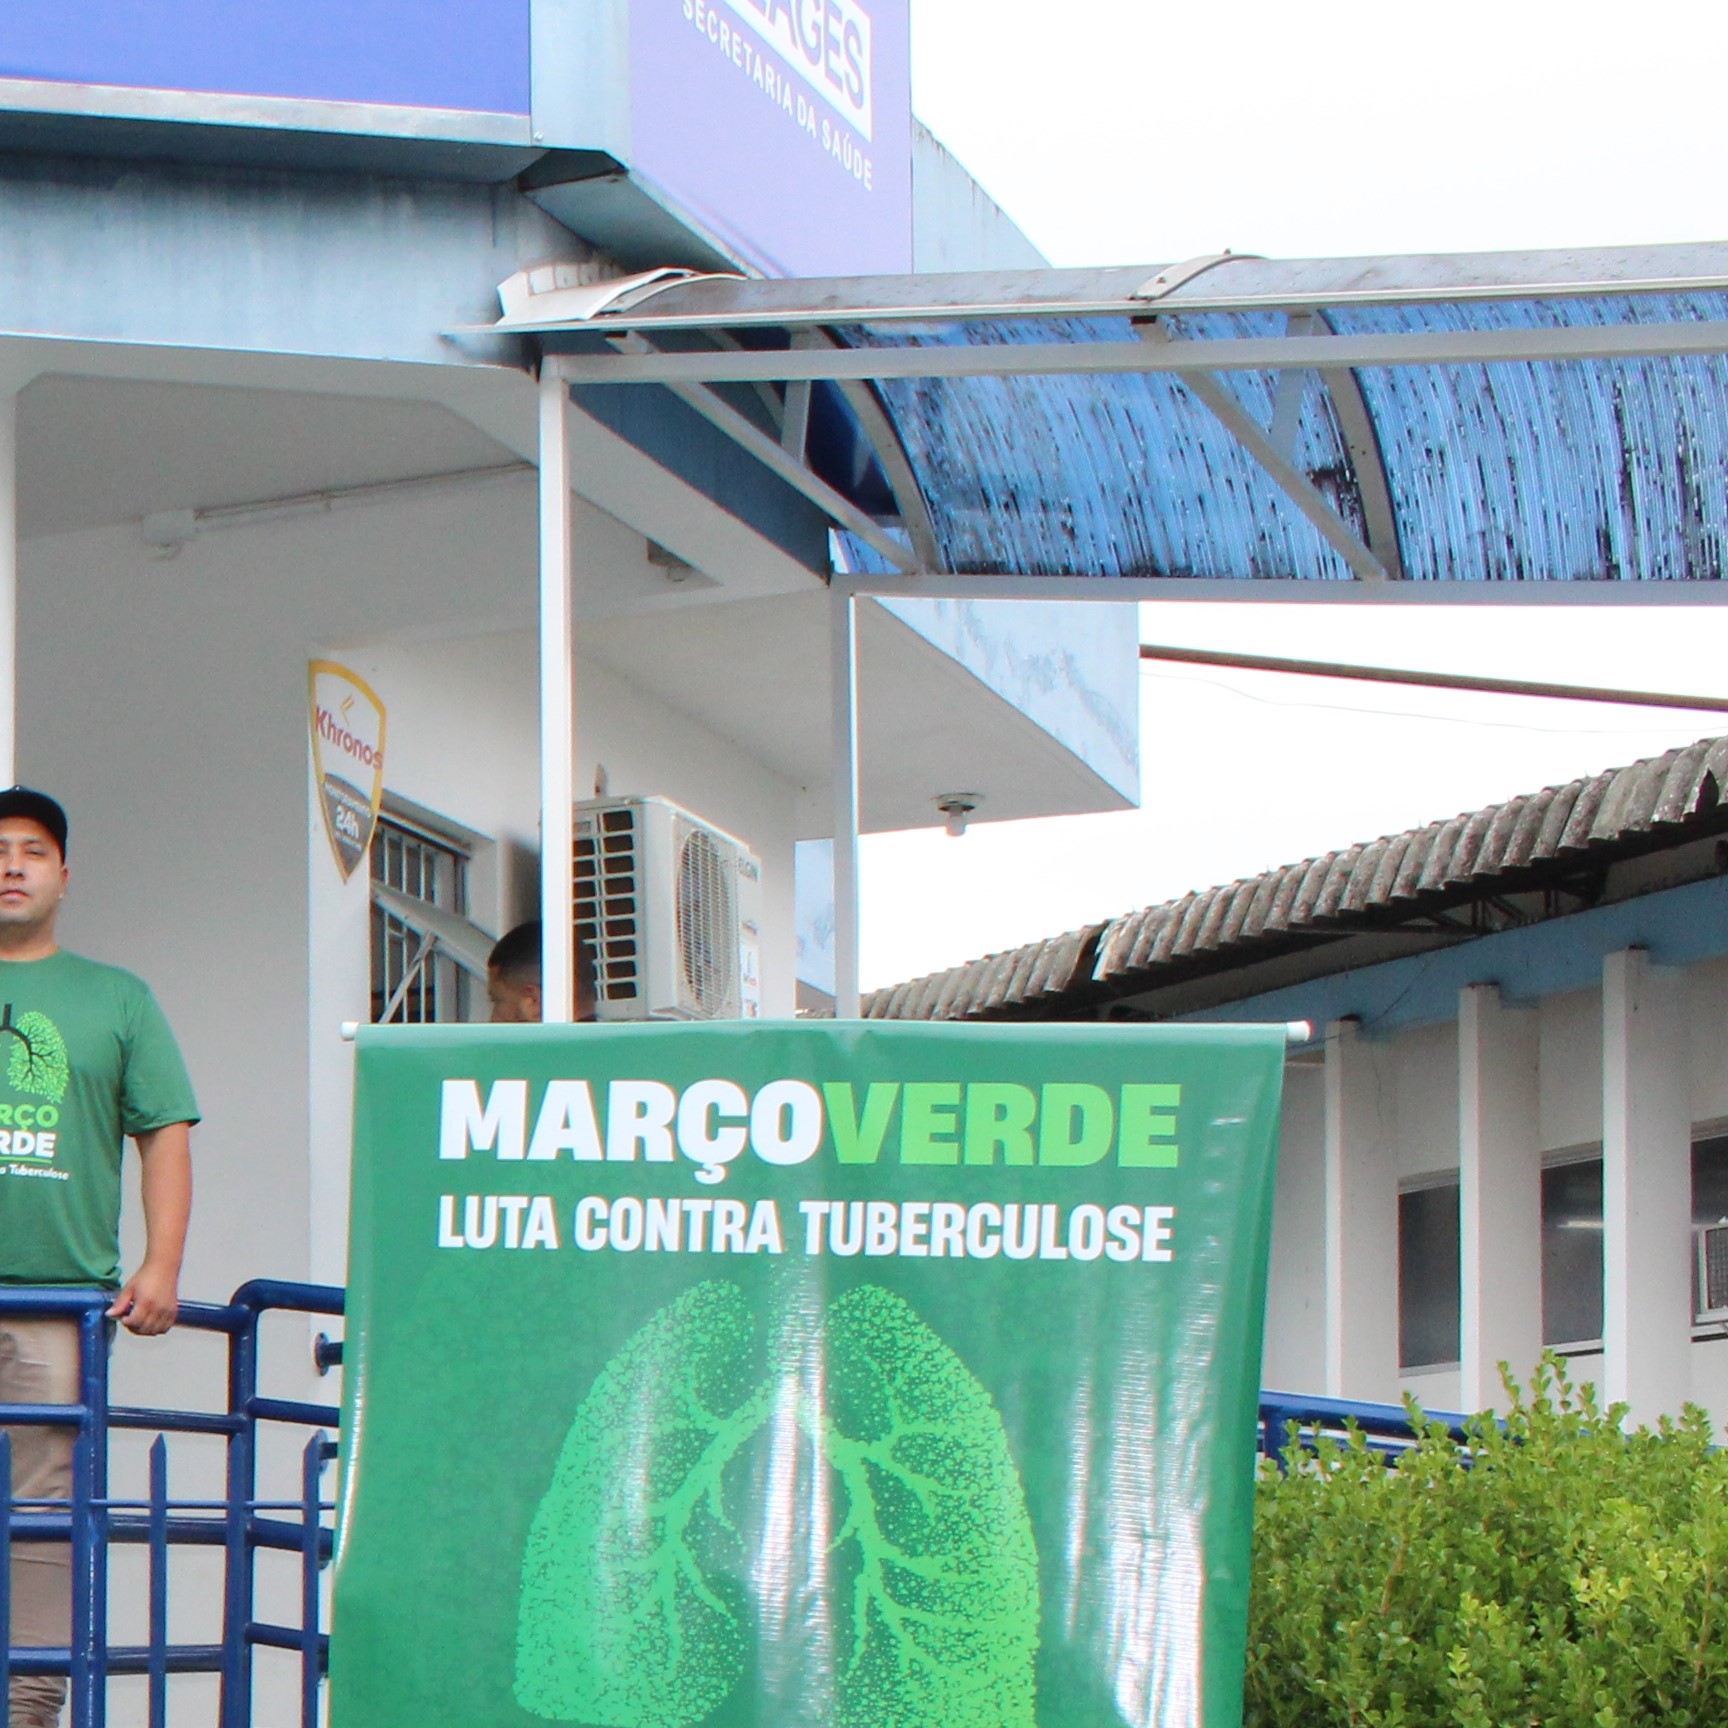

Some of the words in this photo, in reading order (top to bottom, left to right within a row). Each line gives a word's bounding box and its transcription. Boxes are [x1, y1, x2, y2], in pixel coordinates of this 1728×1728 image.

[797, 94, 817, 139] DA
[821, 118, 873, 192] SAÚDE
[316, 706, 384, 771] Khronos
[8, 1164, 70, 1181] Tuberculose
[438, 1195, 559, 1250] LUTA
[574, 1196, 783, 1254] CONTRA
[799, 1201, 1176, 1262] TUBERCULOSE
